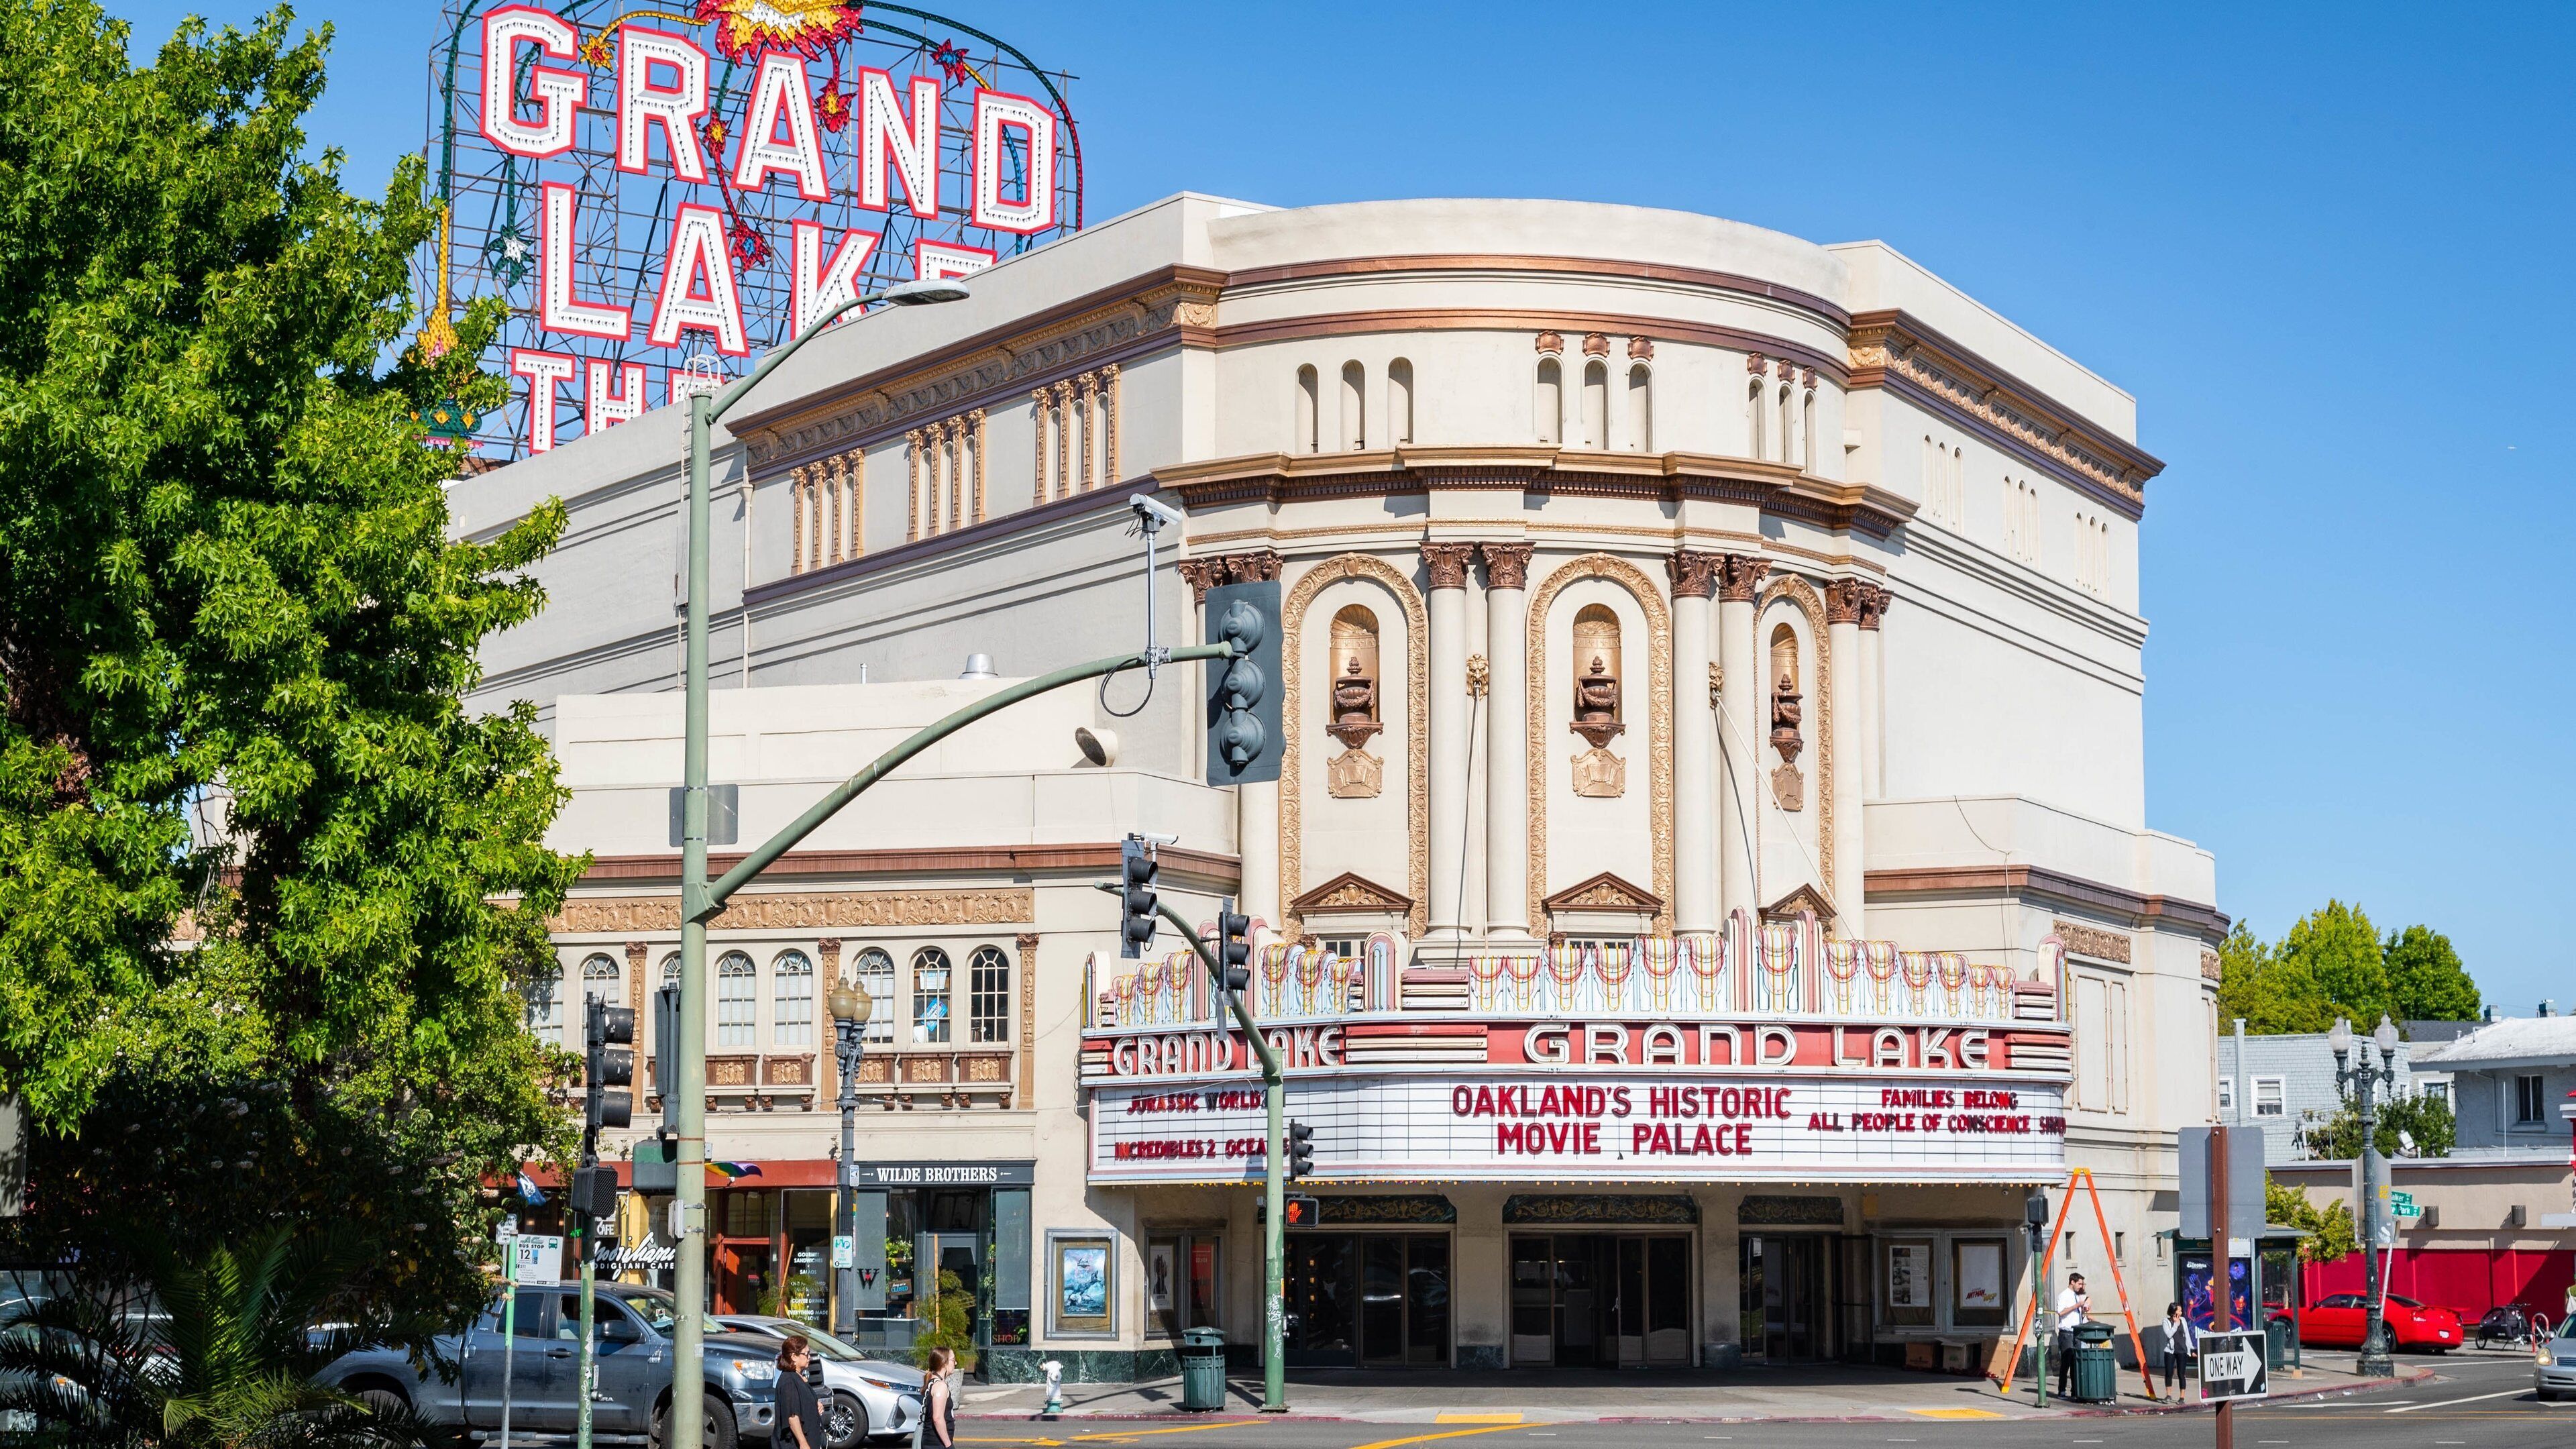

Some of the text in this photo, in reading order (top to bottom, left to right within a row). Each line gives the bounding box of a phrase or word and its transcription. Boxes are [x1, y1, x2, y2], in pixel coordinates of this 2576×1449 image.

[480, 4, 1057, 233] GRAND
[1114, 1025, 1342, 1076] GRAND LAKE
[1523, 1022, 1990, 1069] GRAND LAKE
[1127, 1092, 1200, 1116] JURASSIC
[1205, 1089, 1261, 1112] WORLD
[1452, 1085, 1792, 1120] OAKLAND'S HISTORIC
[1881, 1089, 2019, 1111] FAMILIES BELONG
[1808, 1112, 1843, 1132] ALL
[1852, 1112, 1916, 1132] PEOPLE
[1922, 1114, 1942, 1132] OF
[1947, 1114, 2031, 1135] CONSCIENCE
[1115, 1137, 1290, 1161] INCREDIBLES 2 OCEAS
[1497, 1122, 1753, 1156] MOVIE PALACE
[877, 1167, 920, 1182] WILDE
[924, 1167, 998, 1182] BROTHERS
[596, 1224, 614, 1235] CAFE
[520, 1249, 530, 1260] 12
[991, 1334, 1019, 1344] SHOP
[2209, 1355, 2244, 1378] ONE WAY
